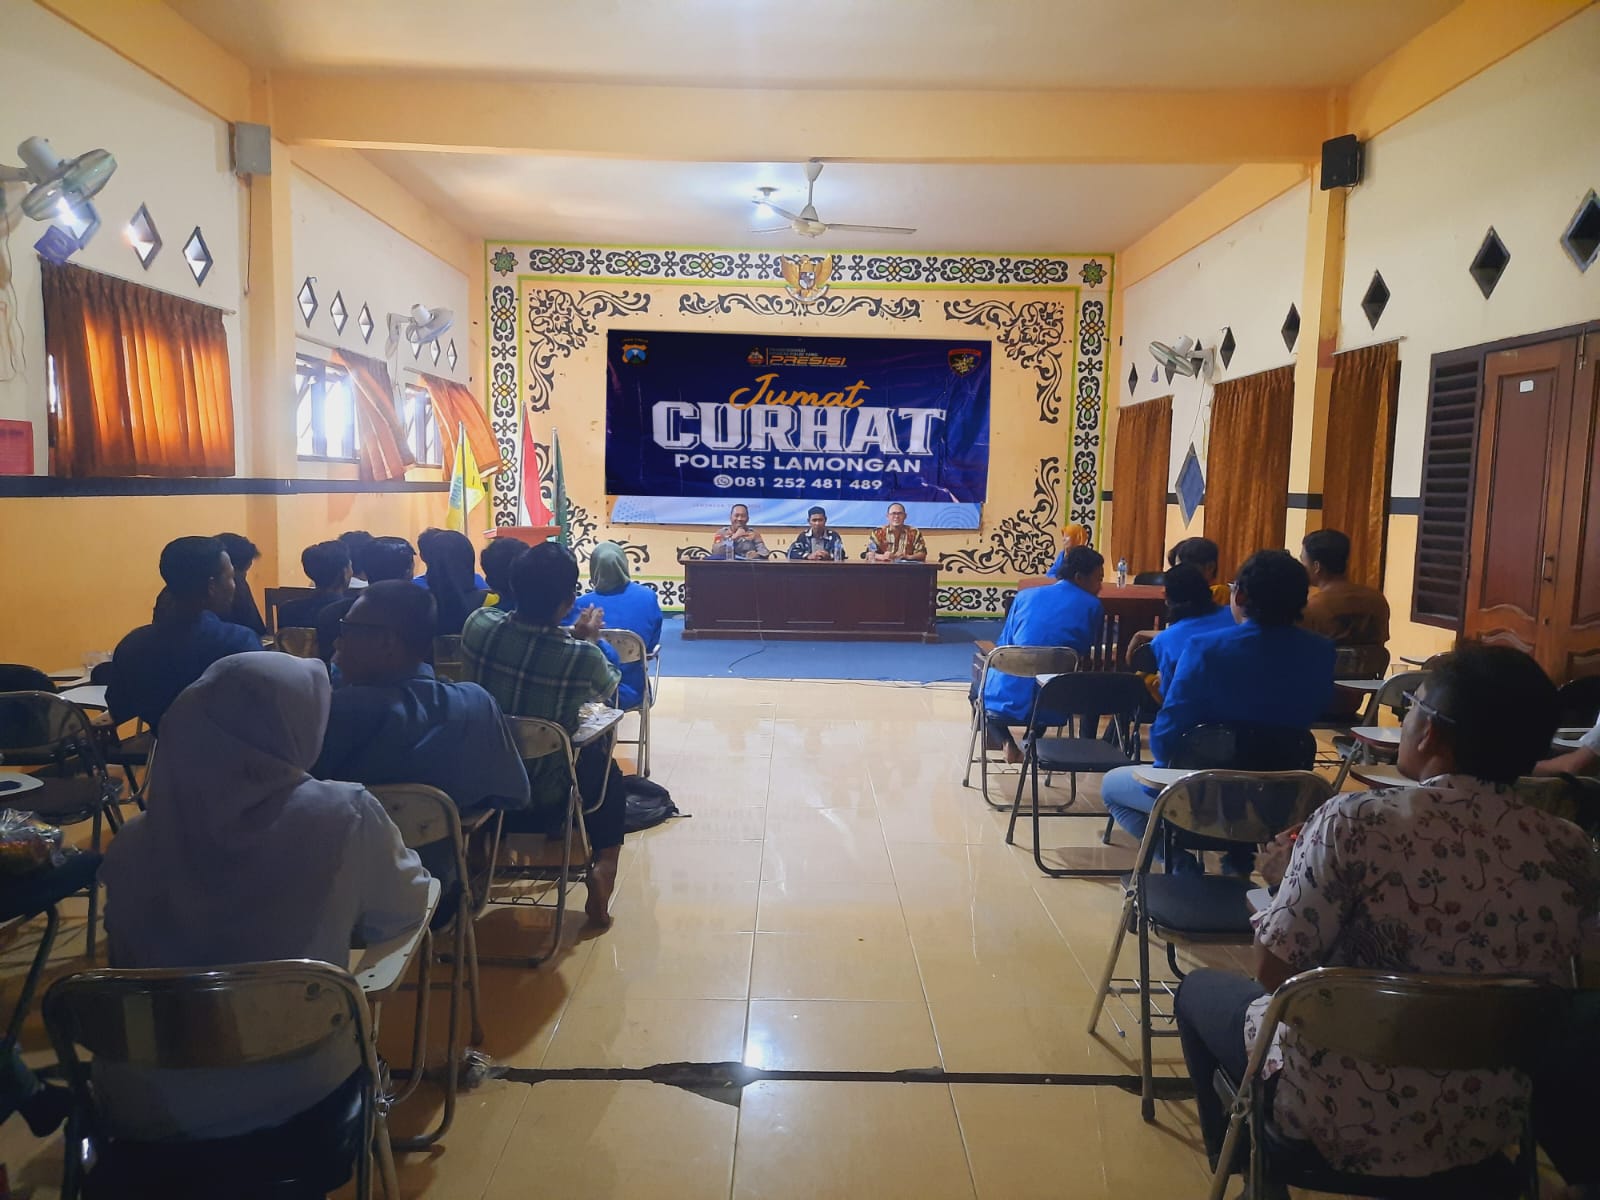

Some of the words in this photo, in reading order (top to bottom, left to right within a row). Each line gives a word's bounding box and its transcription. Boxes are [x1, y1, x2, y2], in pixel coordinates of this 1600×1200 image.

[769, 355, 847, 367] PRESISI
[729, 373, 871, 410] Jumat
[652, 400, 946, 456] CURHAT
[674, 454, 766, 470] POLRES
[774, 456, 921, 473] LAMONGAN
[734, 477, 765, 487] 081
[773, 477, 806, 488] 252
[811, 478, 842, 489] 481
[849, 479, 883, 490] 489
